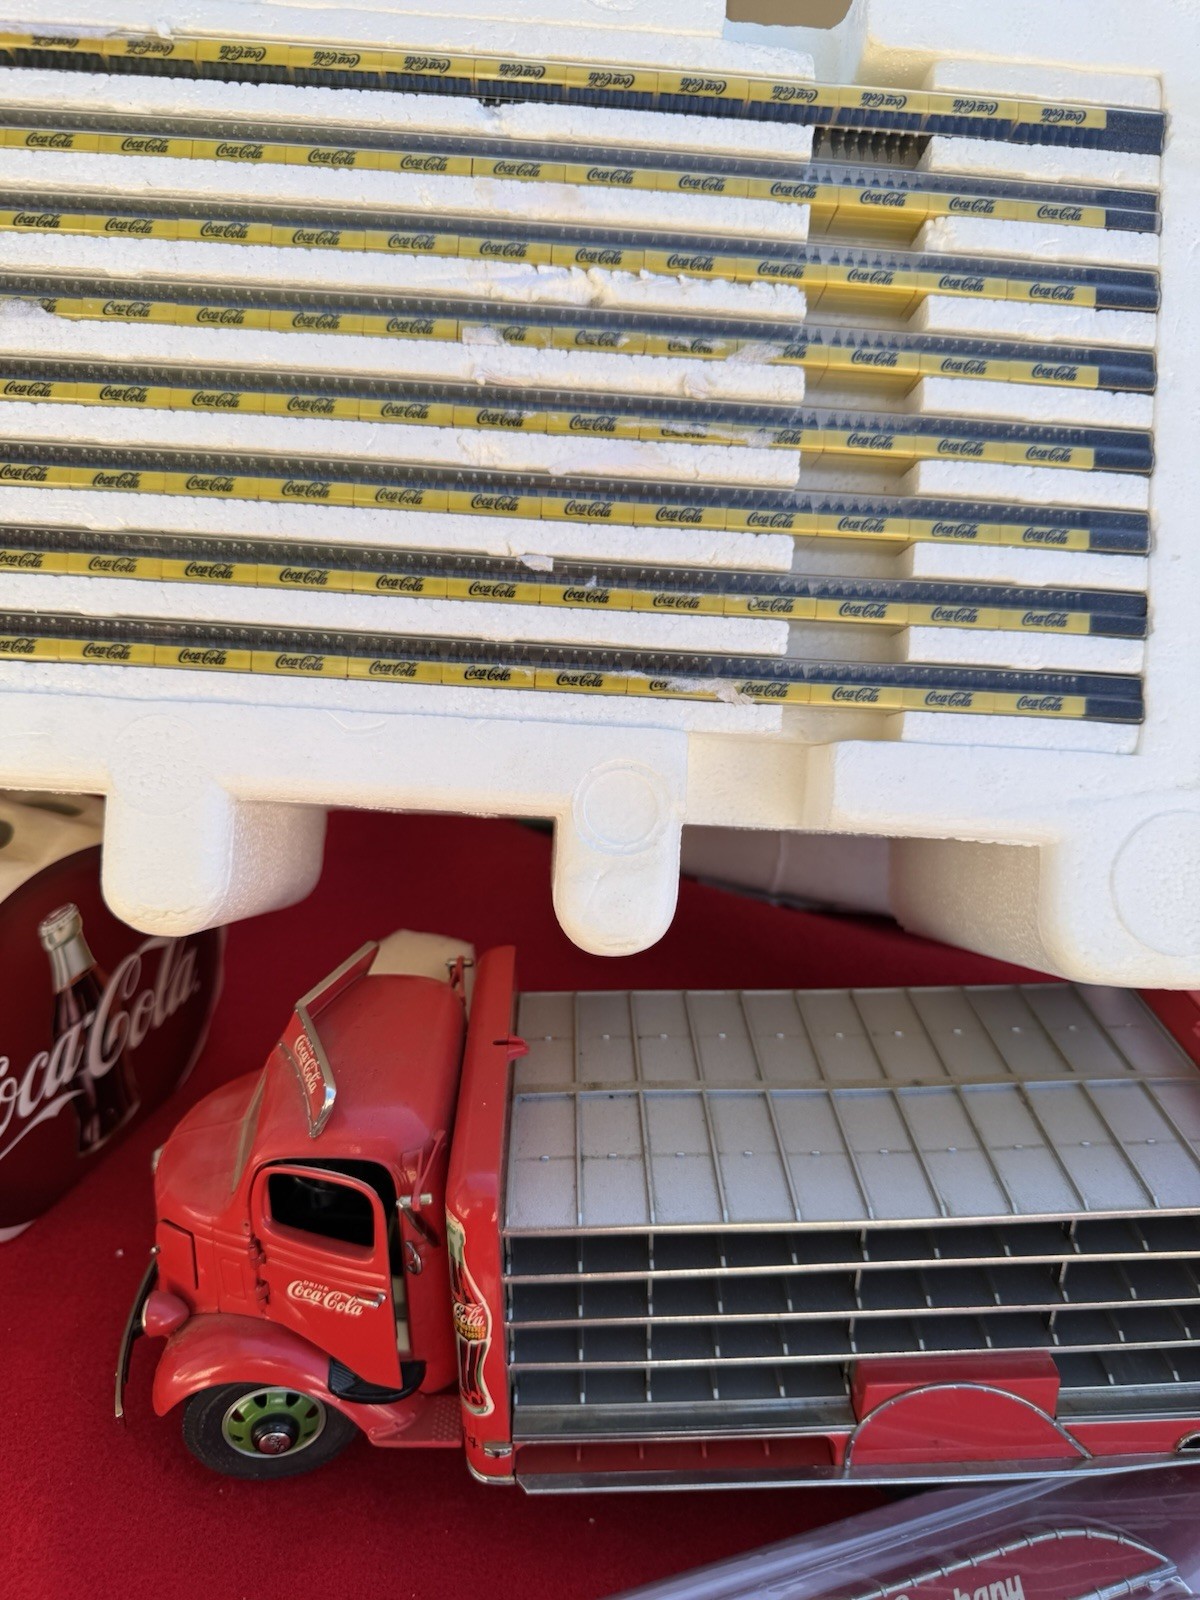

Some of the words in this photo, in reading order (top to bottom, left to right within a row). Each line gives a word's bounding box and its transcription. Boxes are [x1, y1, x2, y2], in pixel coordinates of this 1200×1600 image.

[26, 132, 73, 148] Coca-Cola
[121, 137, 168, 154] Coca-Cola
[216, 143, 263, 159] Coca-Cola
[308, 149, 355, 166] Coca-Cola
[401, 156, 447, 171] Coca-Cola
[494, 161, 540, 177] Coca-Cola
[587, 168, 633, 184] Coca-Cola
[679, 175, 724, 192] Coca-Cola
[771, 182, 816, 199] Coca-Cola
[860, 190, 905, 207] Coca-Cola
[949, 197, 994, 214] Coca-Cola
[1037, 205, 1081, 221] Coca-Cola
[13, 213, 60, 228] Coca-Cola
[105, 218, 152, 234] Coca-Cola
[200, 222, 247, 239] Coca-Cola
[292, 229, 340, 246] Coca-Cola
[388, 234, 434, 250] Coca-Cola
[480, 241, 526, 257] Coca-Cola
[575, 248, 621, 265] Coca-Cola
[667, 254, 713, 272] Coca-Cola
[758, 262, 803, 278] Coca-Cola
[848, 268, 893, 285] Coca-Cola
[939, 276, 984, 293] Coca-Cola
[1030, 284, 1074, 300] Coca-Cola
[103, 301, 150, 318] Coca-Cola
[197, 308, 244, 324] Coca-Cola
[292, 313, 340, 329] Coca-Cola
[387, 318, 433, 335] Coca-Cola
[852, 350, 897, 366] Coca-Cola
[941, 358, 986, 375] Coca-Cola
[1032, 364, 1077, 381] Coca-Cola
[3, 381, 52, 397] Coca-Cola
[100, 386, 147, 402] Coca-Cola
[192, 392, 240, 408] Coca-Cola
[287, 397, 335, 413] Coca-Cola
[380, 402, 428, 419] Coca-Cola
[570, 415, 616, 432] Coca-Cola
[847, 433, 893, 449] Coca-Cola
[938, 440, 983, 456] Coca-Cola
[1026, 446, 1071, 463] Coca-Cola
[93, 472, 140, 489] Coca-Cola
[186, 475, 234, 492] Coca-Cola
[282, 481, 330, 498] Coca-Cola
[375, 488, 422, 505] Coca-Cola
[471, 494, 518, 511] Coca-Cola
[564, 501, 611, 518] Coca-Cola
[656, 507, 702, 524] Coca-Cola
[747, 512, 793, 528] Coca-Cola
[838, 517, 884, 533] Coca-Cola
[932, 523, 977, 539] Coca-Cola
[1023, 528, 1067, 544] Coca-Cola
[89, 557, 136, 573] Coca-Cola
[185, 562, 233, 579] Coca-Cola
[280, 568, 327, 585] Coca-Cola
[376, 574, 424, 592] Coca-Cola
[469, 582, 516, 598] Coca-Cola
[839, 602, 887, 618] Coca-Cola
[931, 607, 977, 623] Coca-Cola
[1022, 612, 1068, 628] Coca-Cola
[0, 638, 35, 654] ca-Cola
[83, 643, 130, 660] Coca-Cola
[178, 649, 226, 666] Coca-Cola
[276, 654, 323, 671] Coca-Cola
[369, 660, 417, 677] Coca-Cola
[832, 687, 880, 703] Coca-Cola
[925, 692, 972, 708] Coca-Cola
[1017, 696, 1063, 712] Coca-Cola
[0, 936, 198, 1160] oca-Cola
[286, 1280, 363, 1316] Coca-Cola
[303, 1280, 329, 1291] DRINK
